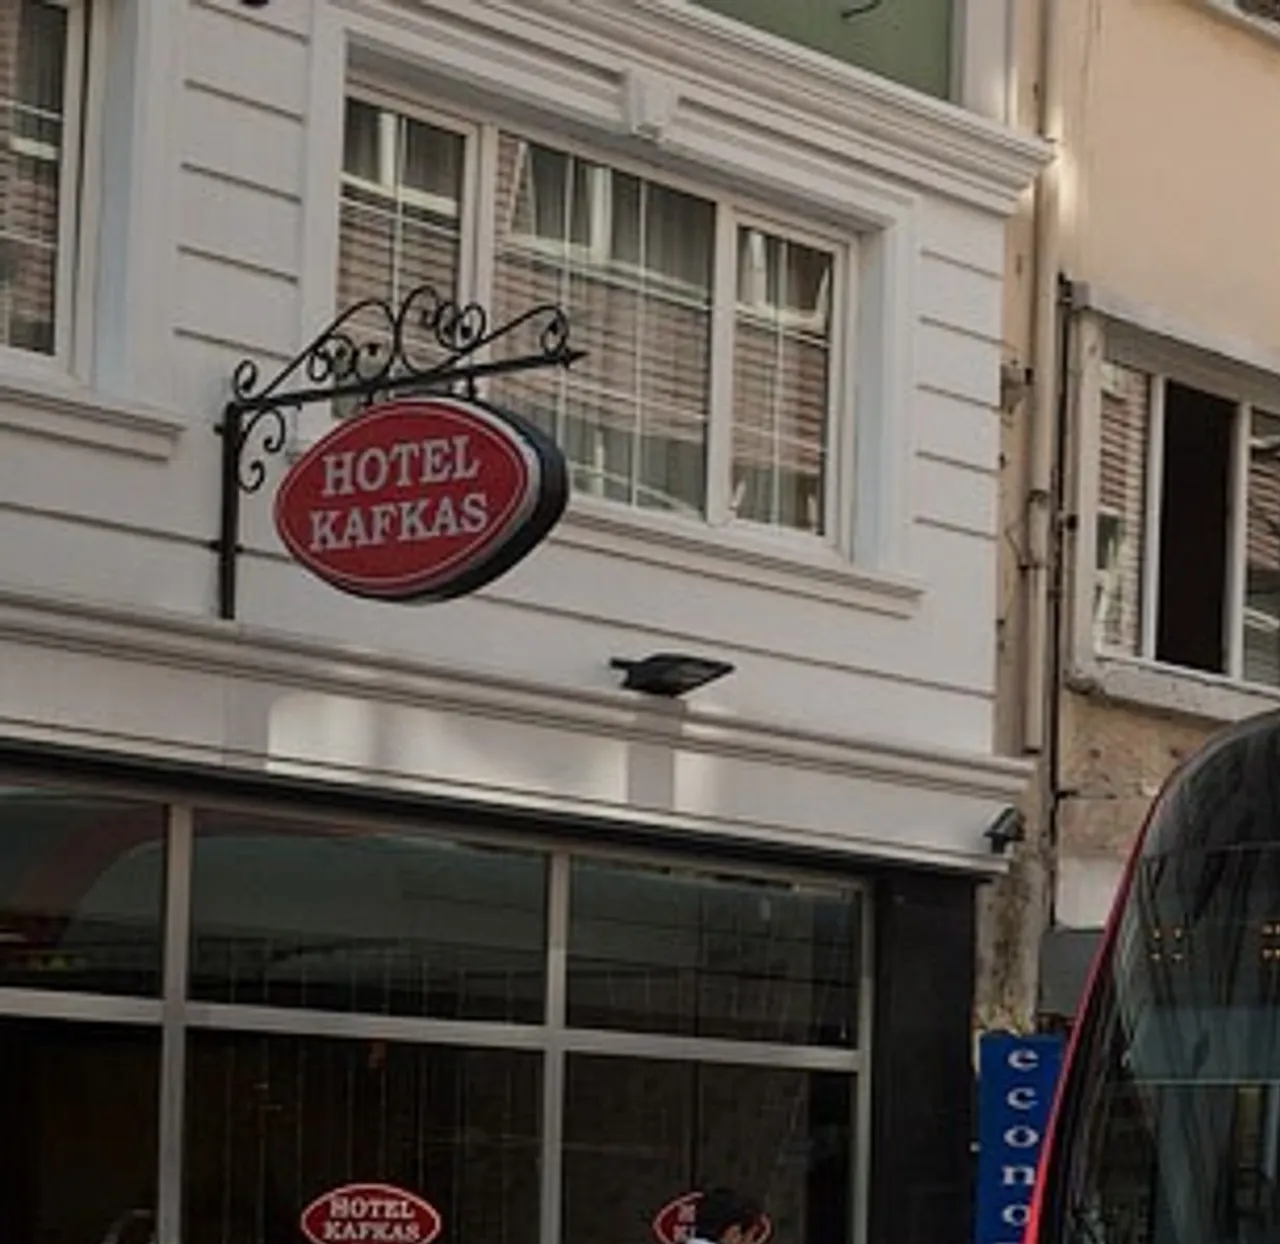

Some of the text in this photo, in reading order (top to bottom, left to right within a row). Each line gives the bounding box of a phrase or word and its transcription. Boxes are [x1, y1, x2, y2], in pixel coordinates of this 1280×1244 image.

[324, 436, 479, 498] HOTEL
[309, 492, 488, 553] KAFKAS
[328, 1196, 416, 1219] HOTEL
[322, 1220, 422, 1243] KAFKAS
